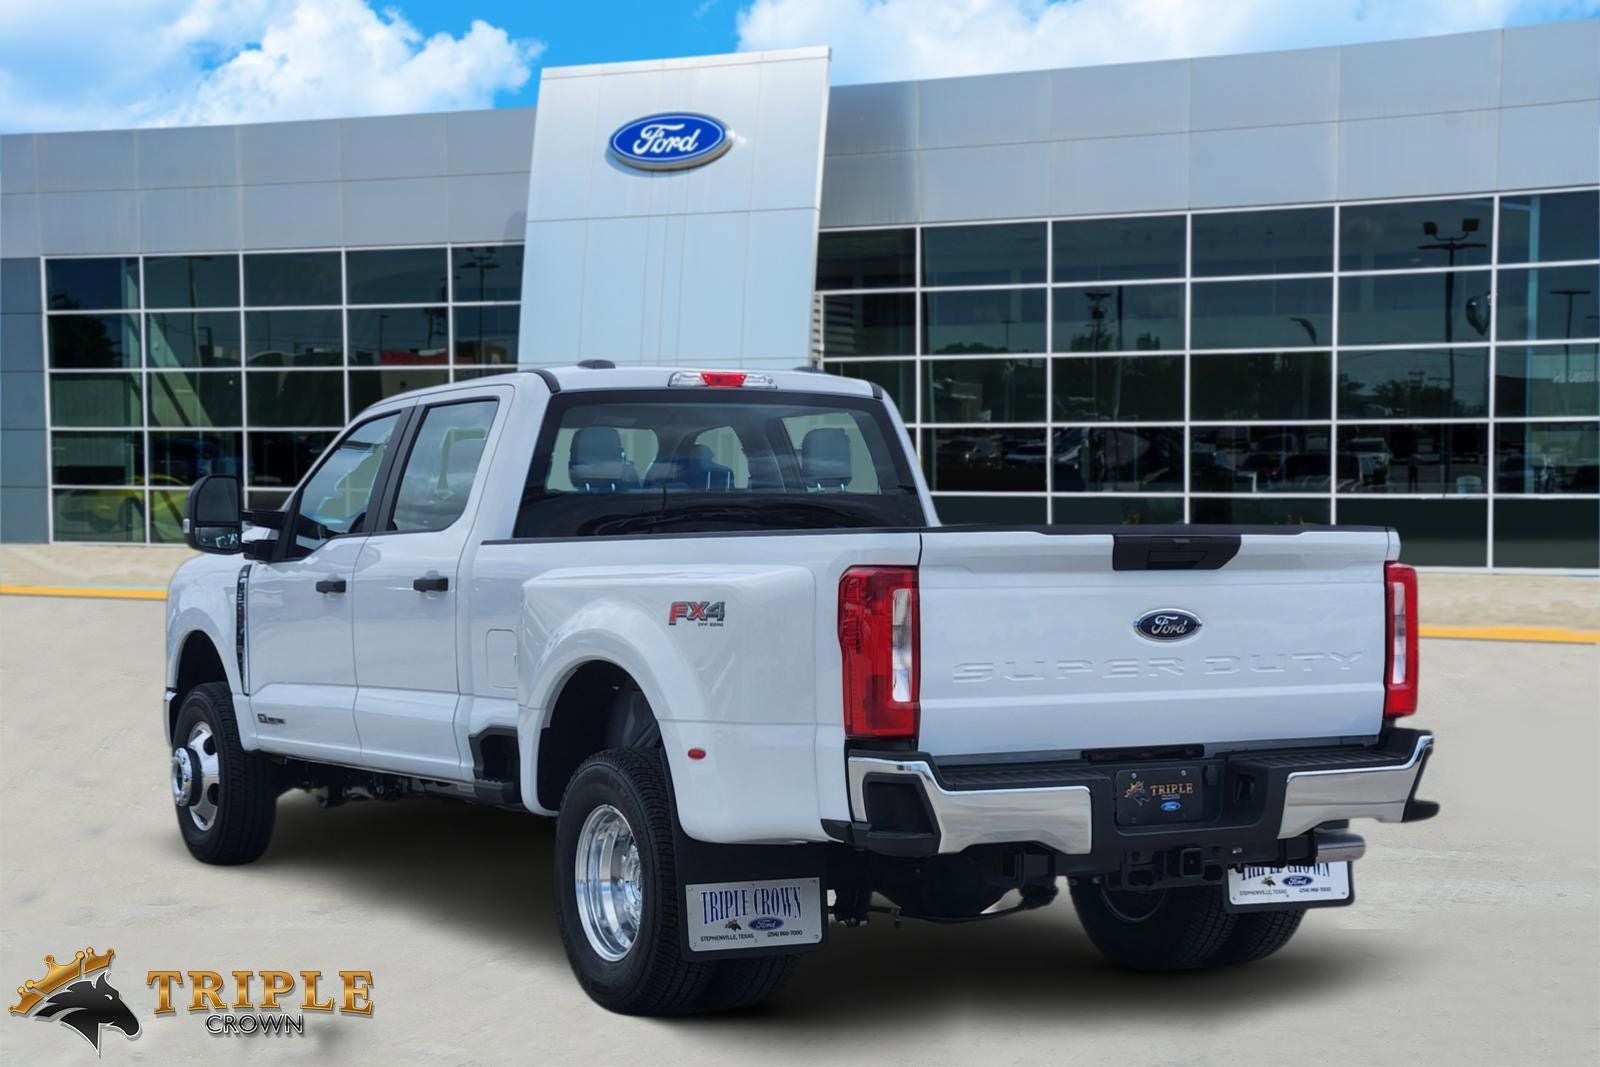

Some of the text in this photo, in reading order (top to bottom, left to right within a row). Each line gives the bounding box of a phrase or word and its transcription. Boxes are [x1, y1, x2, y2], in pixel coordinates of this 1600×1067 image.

[632, 123, 701, 155] Ford
[668, 601, 725, 626] FX4
[1151, 615, 1188, 634] Ford
[952, 650, 1363, 684] SUPER DUTY
[1150, 783, 1194, 797] TRIPLE
[701, 886, 802, 925] TRIPLE CROWN
[755, 919, 776, 929] Ford
